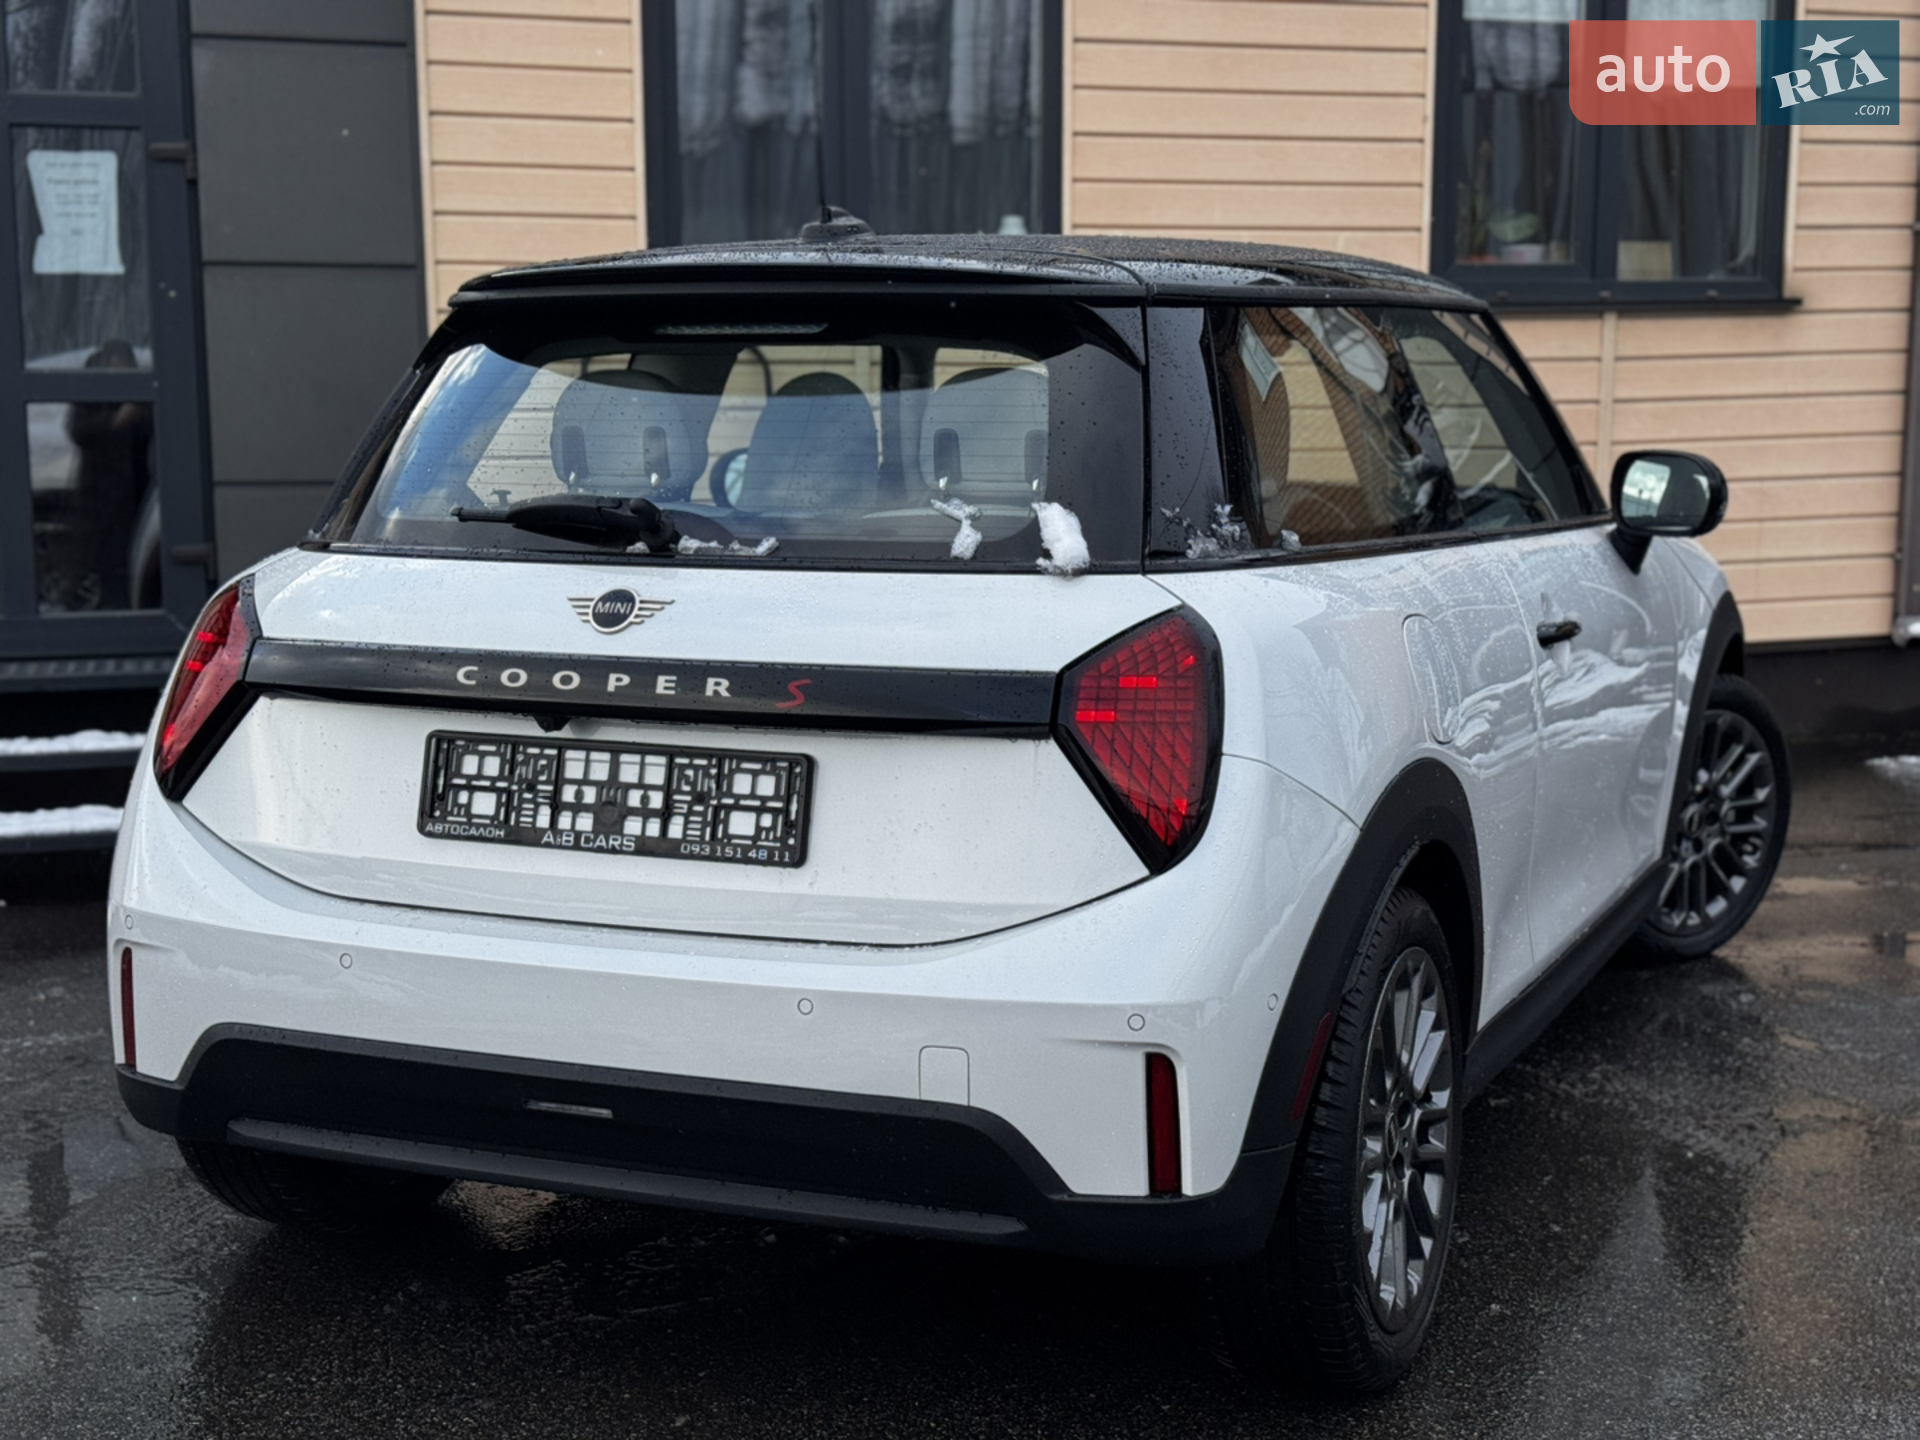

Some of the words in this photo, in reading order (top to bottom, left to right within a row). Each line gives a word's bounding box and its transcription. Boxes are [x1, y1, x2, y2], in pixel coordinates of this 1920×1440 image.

[595, 600, 633, 615] MINI
[456, 665, 731, 698] COOPER
[775, 678, 812, 710] S
[425, 822, 505, 839] АВТОСАЛОН
[580, 832, 636, 852] CARS
[680, 842, 710, 855] 093
[715, 845, 742, 858] 151
[748, 848, 767, 860] 48
[773, 850, 790, 862] 11
